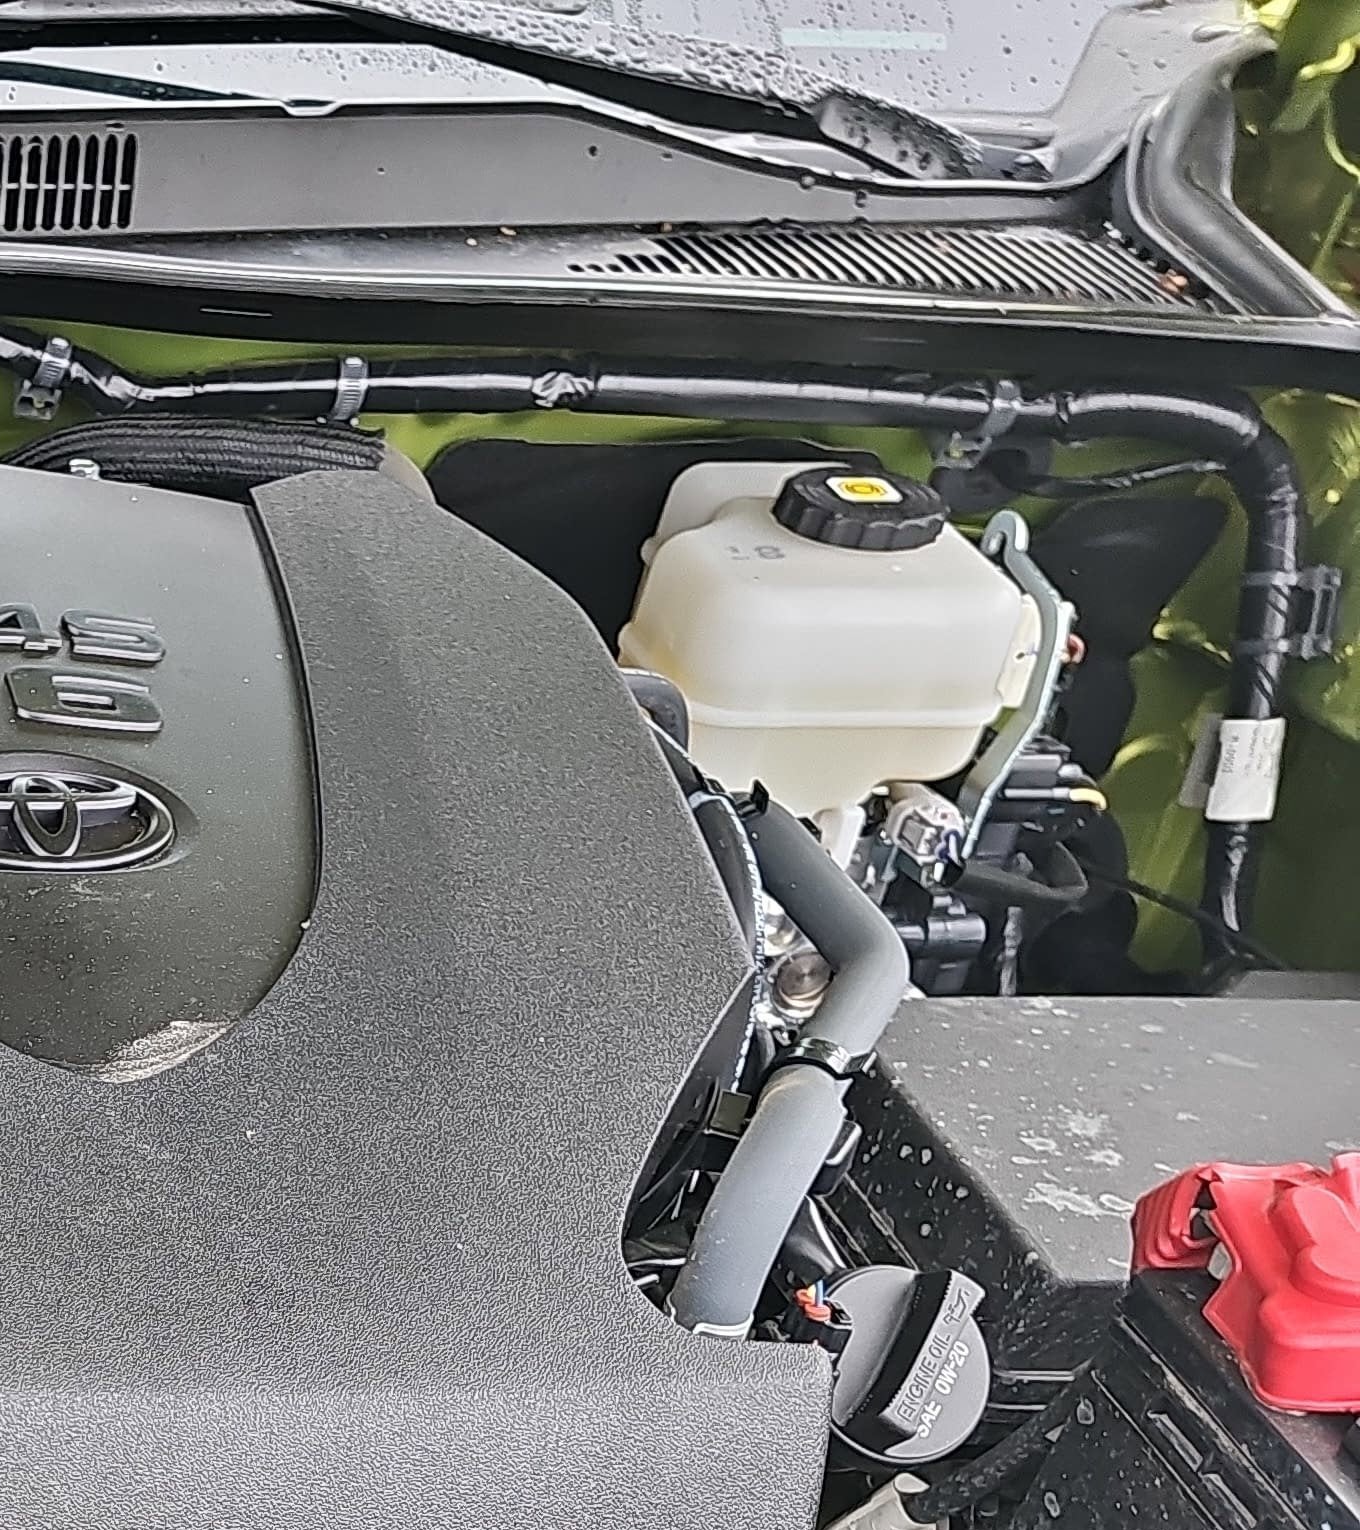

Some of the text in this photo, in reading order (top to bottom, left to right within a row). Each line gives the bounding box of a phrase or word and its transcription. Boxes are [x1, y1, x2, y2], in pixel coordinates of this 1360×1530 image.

[896, 1333, 951, 1423] ENGINE OIL
[916, 1340, 970, 1439] SAE 0W-20
